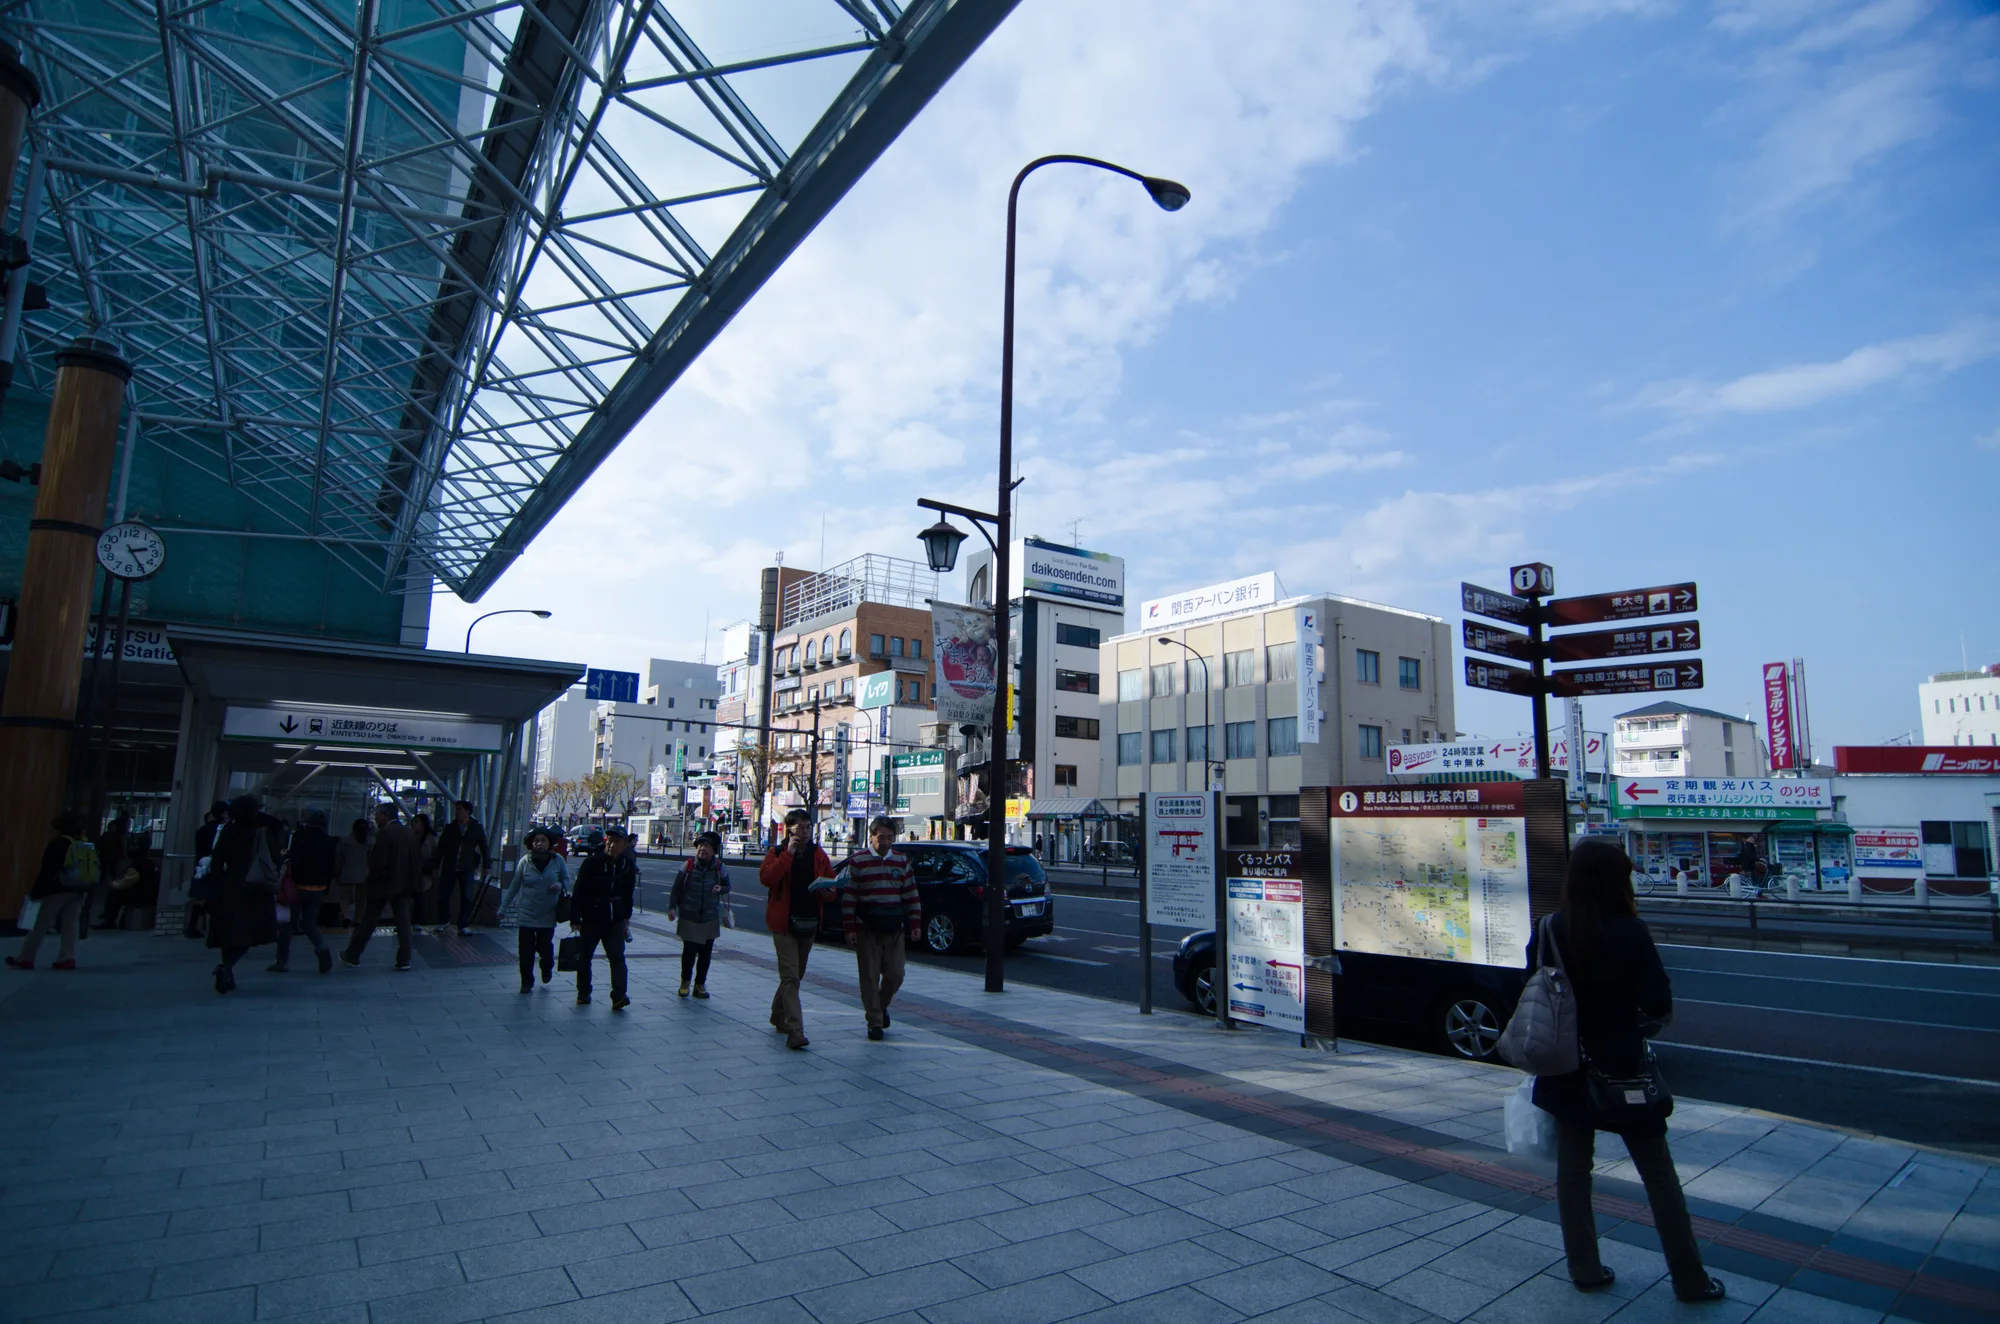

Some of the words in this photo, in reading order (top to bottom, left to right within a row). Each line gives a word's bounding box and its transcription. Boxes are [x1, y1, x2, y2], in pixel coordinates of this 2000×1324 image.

[107, 534, 119, 544] 10
[129, 529, 140, 538] 12
[104, 544, 112, 553] 9
[149, 540, 156, 548] 2
[107, 552, 115, 561] 8
[151, 549, 159, 558] 3
[115, 561, 122, 569] 7
[147, 558, 154, 566] 4
[125, 564, 133, 573] 6
[1032, 562, 1116, 589] daikosenden.com
[1171, 582, 1260, 616] 関西アーバン銀行
[1611, 595, 1644, 607] 東大寺
[1613, 632, 1647, 643] 興福寺
[1574, 668, 1650, 684] 奈良国立博物館
[868, 680, 888, 698] レイク
[1304, 642, 1315, 734] 関西アーバン銀行
[332, 719, 398, 732] 近鉄線のりば
[1768, 680, 1787, 766] ニッポンレンタカー
[331, 730, 366, 738] KINTETSU
[1442, 746, 1485, 757] 24時間営業
[1489, 738, 1601, 759] イージパク
[1403, 748, 1438, 765] easypark
[1443, 758, 1485, 768] 年中無休
[855, 779, 866, 790] レイク
[1666, 780, 1773, 791] 定期観光バス
[1780, 786, 1821, 797] のりば
[1363, 789, 1479, 803] 奈良公園観光案内図
[1667, 793, 1775, 805] 夜行高速・リムジンバス
[1159, 799, 1201, 807] 美化促進重点地域
[1159, 807, 1201, 815] 路上喫煙禁止地域
[1665, 807, 1791, 818] ようこそ奈良・大和路へ
[1237, 853, 1292, 865] ぐるっとバス
[1241, 867, 1287, 877] 乗り場のご案内
